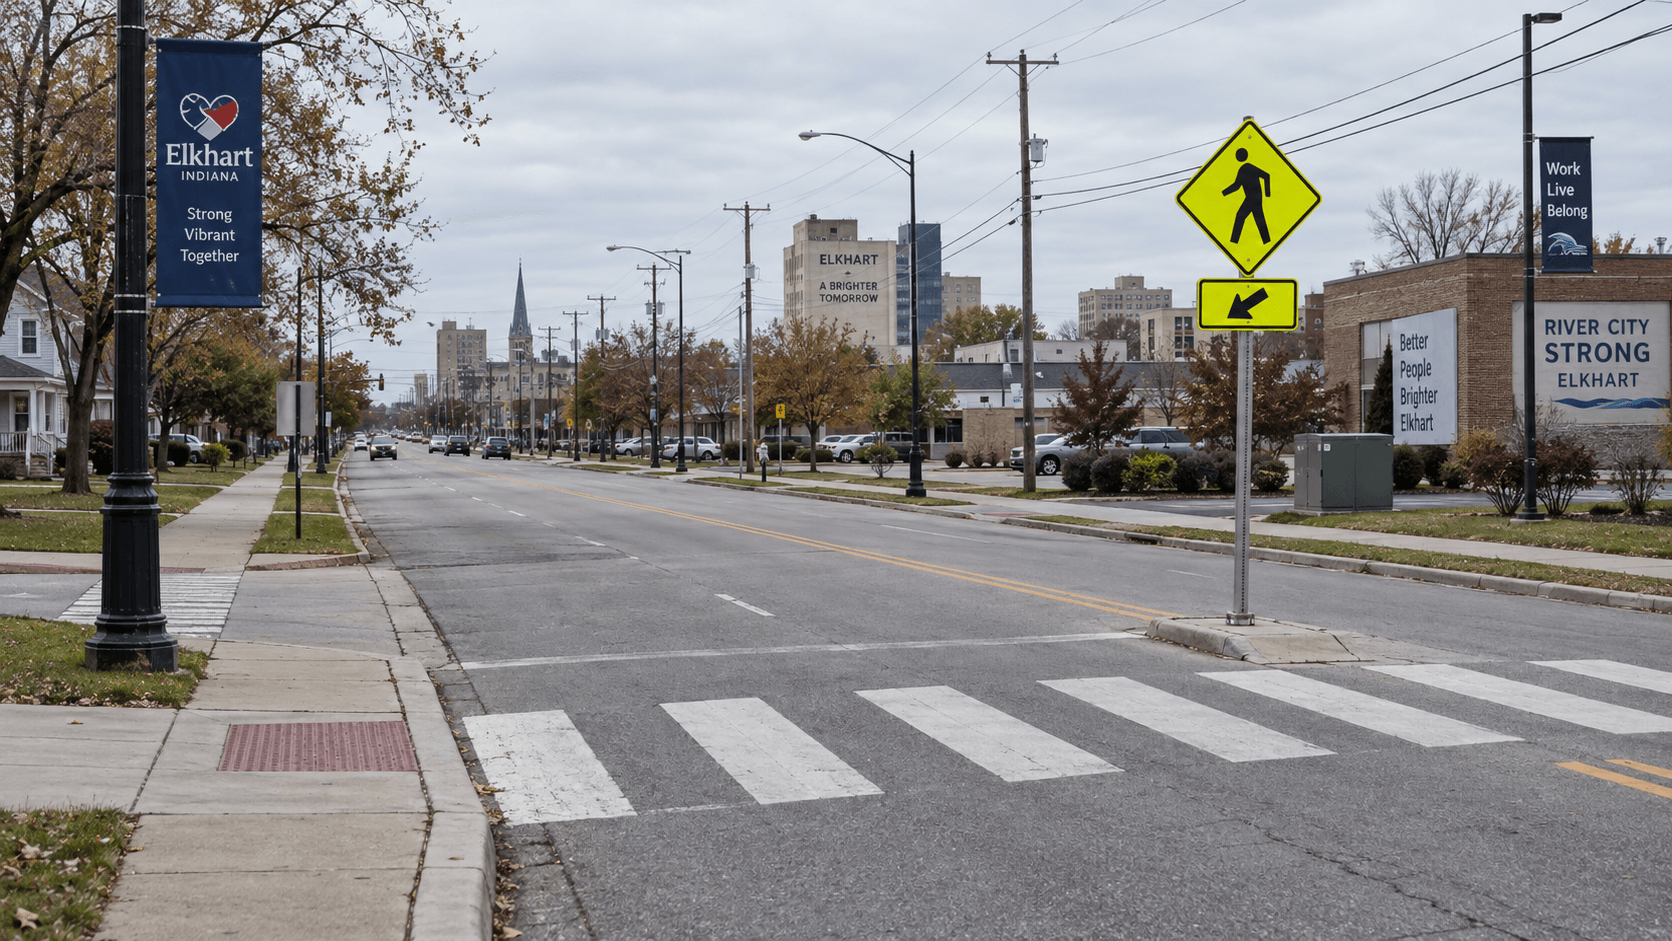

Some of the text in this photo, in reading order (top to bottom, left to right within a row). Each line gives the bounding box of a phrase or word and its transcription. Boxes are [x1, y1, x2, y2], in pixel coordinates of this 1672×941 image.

[165, 143, 254, 167] Elkhart
[181, 171, 239, 182] INDIANA
[1546, 161, 1581, 176] Work
[1547, 182, 1575, 197] Live
[187, 207, 232, 223] Strong
[1547, 203, 1588, 220] Belong
[184, 228, 236, 242] Vibrant
[180, 248, 240, 265] Together
[820, 254, 879, 265] ELKHART
[819, 281, 878, 291] A BRIGHTER
[819, 293, 879, 303] TOMORROW
[1545, 319, 1650, 335] RIVER CITY
[1400, 333, 1429, 352] Better
[1545, 342, 1650, 363] STRONG
[1400, 358, 1432, 382] People
[1558, 372, 1640, 388] ELKHART
[1400, 385, 1438, 409] Brighter
[1400, 413, 1434, 432] Elkhart
